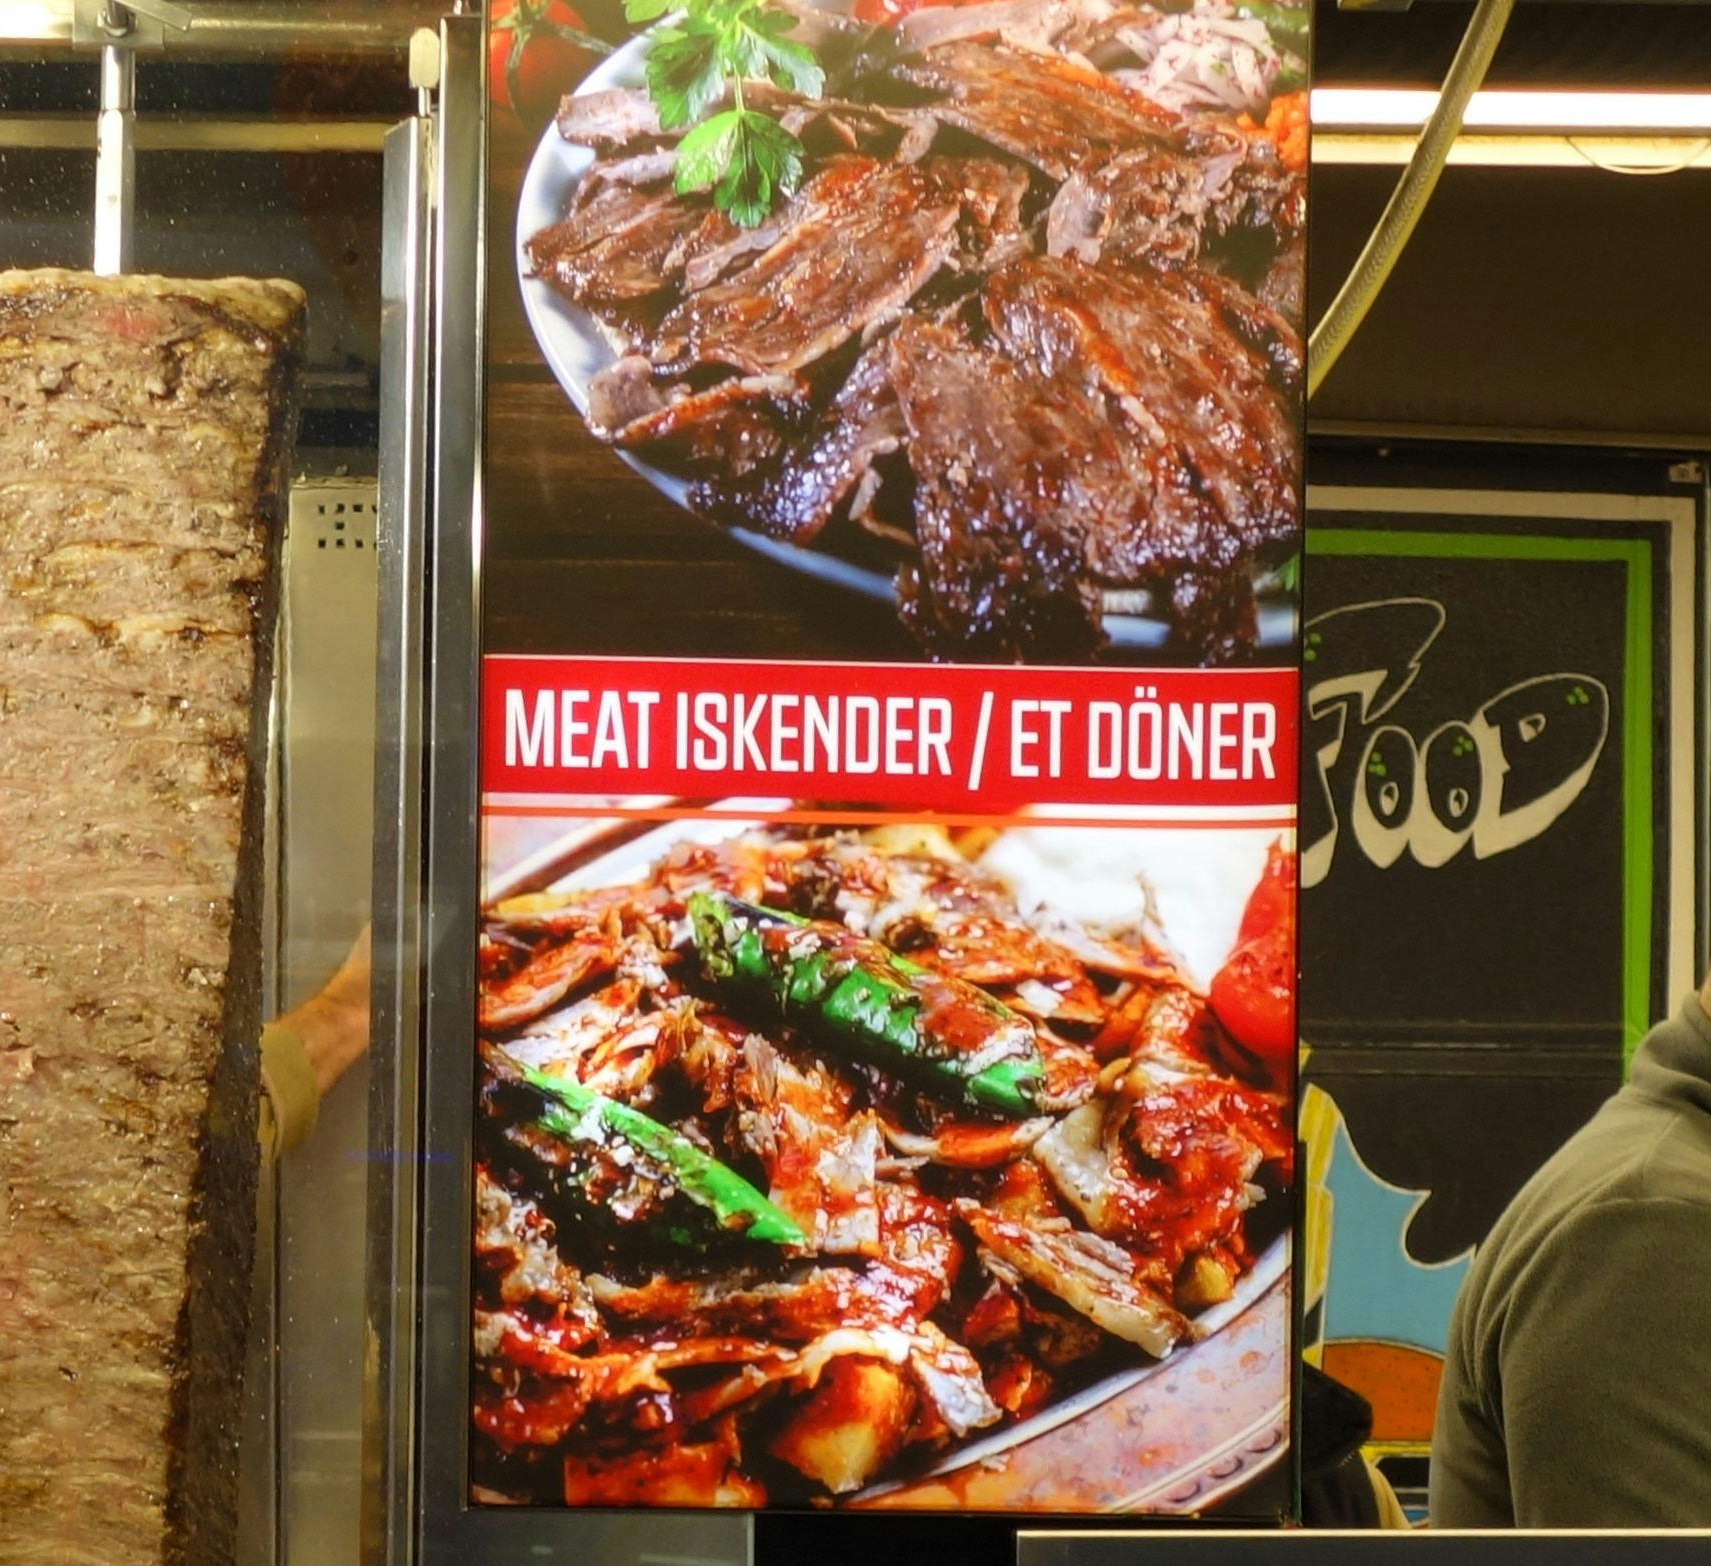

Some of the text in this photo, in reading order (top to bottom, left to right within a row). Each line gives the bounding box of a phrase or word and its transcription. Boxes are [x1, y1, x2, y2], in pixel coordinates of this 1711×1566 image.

[505, 686, 1277, 792] MEAT ISKENDER / ET DÖNER
